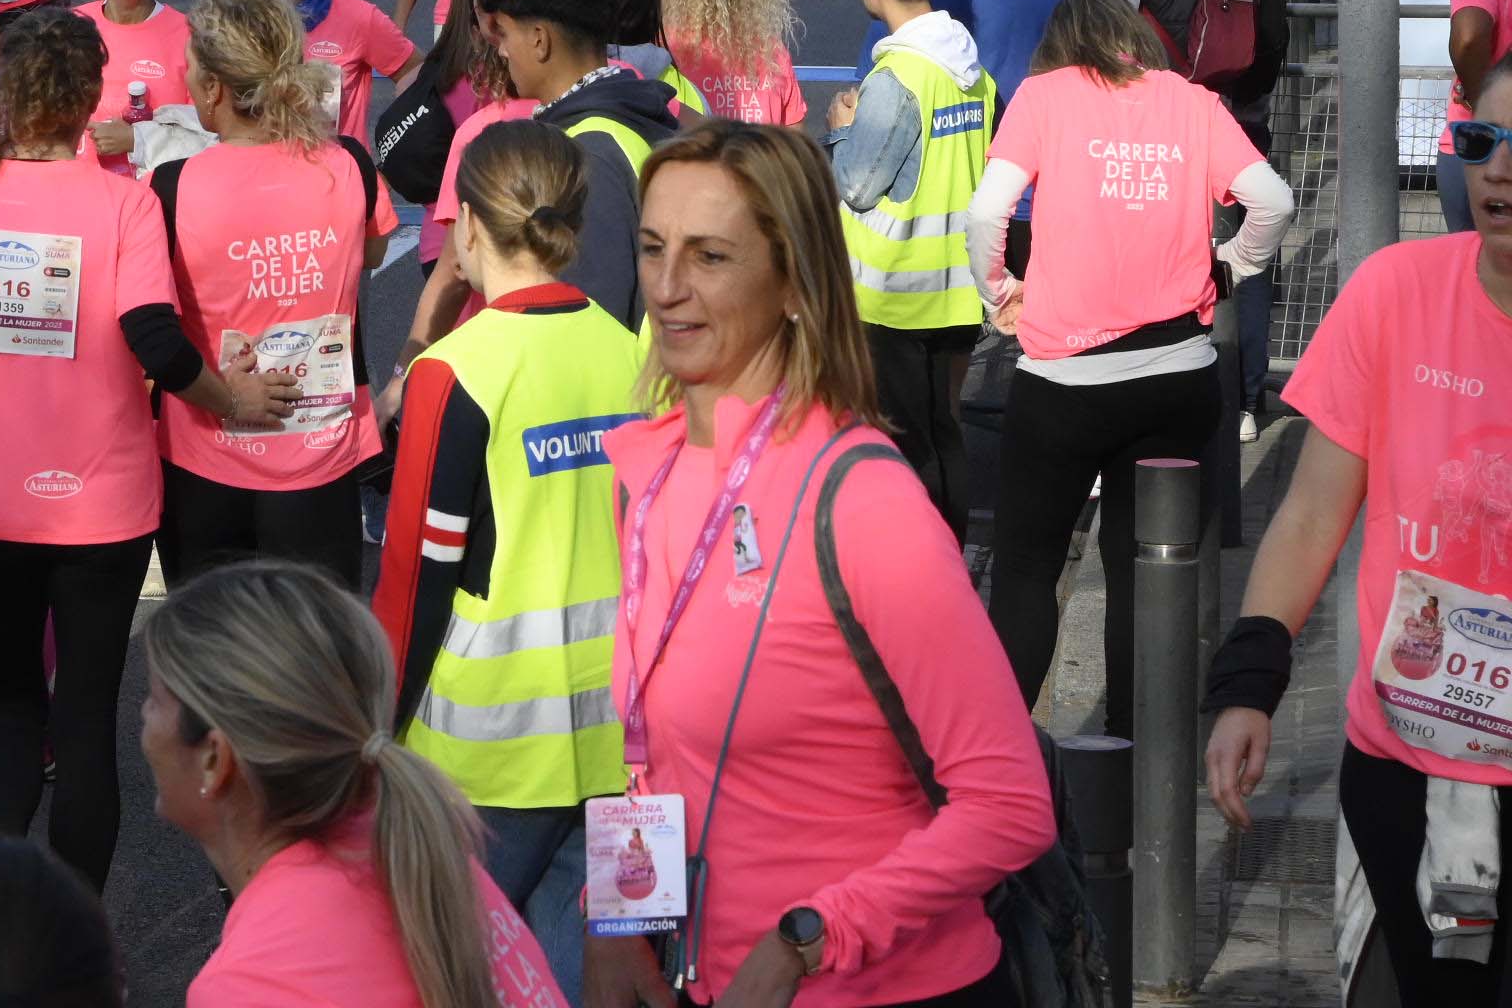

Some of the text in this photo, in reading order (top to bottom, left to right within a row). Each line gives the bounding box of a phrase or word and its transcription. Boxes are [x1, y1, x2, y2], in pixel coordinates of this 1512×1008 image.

[703, 74, 772, 92] CARRERA
[716, 92, 760, 108] DE LA
[1088, 139, 1183, 164] CARRERA
[1105, 163, 1165, 182] DE LA
[1099, 181, 1169, 202] MUJER
[228, 226, 338, 262] CARRERA
[251, 255, 320, 280] DE LA
[246, 271, 325, 301] MUJER
[15, 319, 42, 327] MUJER
[22, 336, 64, 346] Santander
[262, 341, 311, 352] ASTURIANA
[1415, 364, 1485, 397] OYSHO
[529, 429, 605, 462] VOLUNT
[30, 479, 79, 491] ASTURIANA
[1397, 514, 1438, 562] TU
[1446, 653, 1511, 690] 016
[1389, 691, 1440, 714] CARRERA
[1443, 709, 1458, 720] DE
[1460, 711, 1475, 724] LA
[1443, 684, 1495, 709] 29557
[622, 815, 666, 825] MUJER
[596, 918, 677, 933] ORGANIZACIÓN
